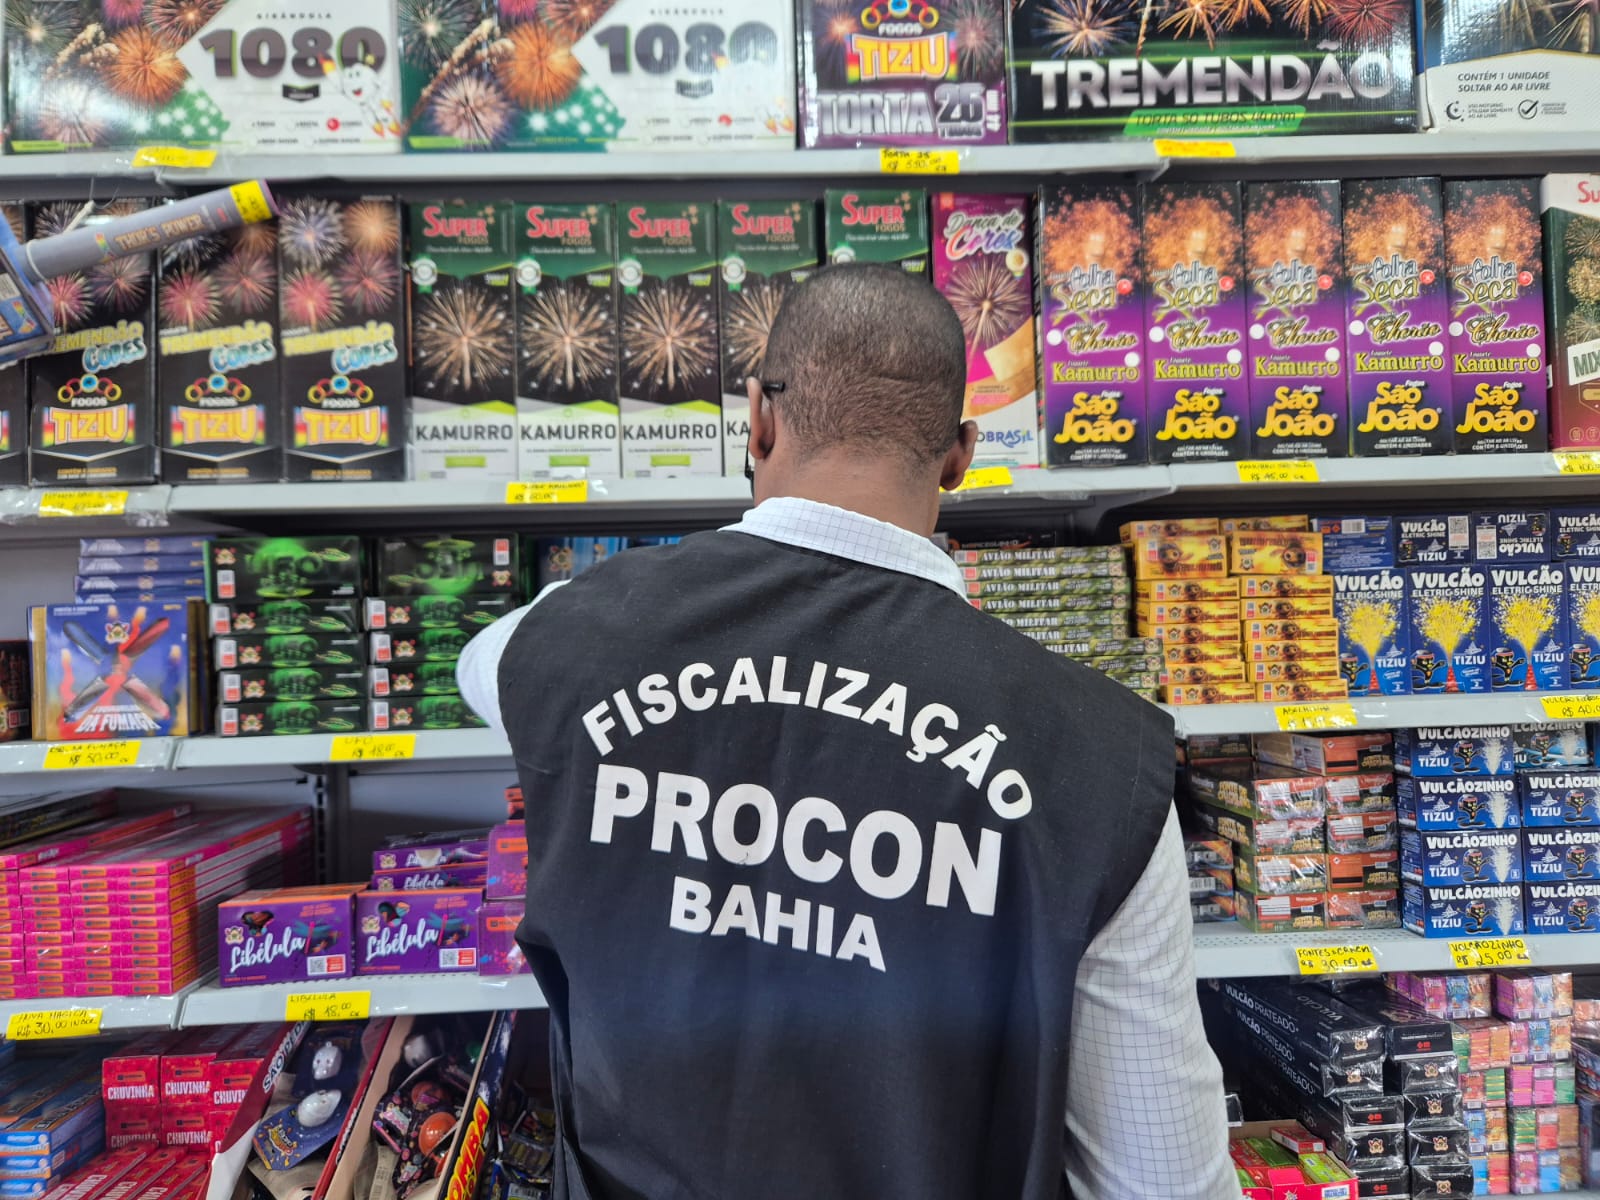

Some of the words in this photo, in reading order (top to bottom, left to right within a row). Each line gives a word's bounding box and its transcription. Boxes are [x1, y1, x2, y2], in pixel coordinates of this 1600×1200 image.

[878, 24, 923, 36] FOGOS
[199, 27, 386, 78] 1080
[594, 21, 777, 75] 1080
[850, 34, 951, 81] TIZIU
[1030, 40, 1395, 110] TREMENDÃO
[1457, 70, 1497, 82] CONTÉM
[1507, 71, 1550, 80] UNIDADE
[1457, 84, 1492, 92] SOLTAR
[1494, 83, 1508, 92] AO
[1510, 83, 1523, 91] AR
[1525, 82, 1551, 91] LIVRE
[817, 91, 935, 135] TORTA
[1136, 114, 1177, 126] TORTA
[1205, 111, 1247, 124] TUBOS
[944, 225, 1022, 259] Cores
[1053, 359, 1140, 383] Kamurro
[1154, 356, 1242, 380] Kamurro
[1255, 354, 1339, 377] Kamurro
[1355, 352, 1444, 374] Kamurro
[1454, 353, 1541, 374] Kamurro
[1175, 389, 1220, 413] São
[1274, 386, 1318, 411] São
[1376, 381, 1422, 405] São
[1473, 382, 1519, 406] São
[1072, 392, 1118, 416] São
[50, 406, 128, 445] TIZIU
[178, 407, 259, 444] TIZIU
[302, 407, 382, 445] TIZIU
[1156, 408, 1237, 440] João
[1256, 405, 1335, 437] João
[1357, 401, 1440, 432] João
[1455, 402, 1536, 434] João
[416, 424, 513, 441] KAMURRO
[520, 423, 616, 440] KAMURRO
[623, 423, 717, 440] KAMURRO
[1054, 412, 1135, 444] João
[1401, 518, 1446, 532] VULCÃO
[1498, 513, 1527, 523] TIZIU
[982, 550, 1011, 561] AVIÃO
[1015, 549, 1055, 560] MILITAR
[1417, 552, 1447, 562] TIZIU
[982, 566, 1011, 578] AVIÃO
[1014, 566, 1056, 577] MILITAR
[1334, 570, 1403, 591] VULCÃO
[1411, 565, 1485, 588] VULCÃO
[1490, 564, 1564, 586] VULCÃO
[985, 582, 1014, 593] AVIÃO
[1018, 582, 1060, 593] MILITAR
[1374, 590, 1403, 599] SHINE
[1454, 587, 1484, 596] SHINE
[1533, 584, 1563, 594] SHINE
[985, 598, 1015, 610] AVIÃO
[1019, 598, 1060, 609] MILITAR
[1376, 656, 1407, 668] TIZIU
[1454, 655, 1486, 666] TIZIU
[1533, 652, 1564, 663] TIZIU
[582, 655, 1032, 819] FISCALIZAÇÃO
[1418, 757, 1449, 768] TIZIU
[1420, 777, 1514, 794] VULCÃOZINHO
[1423, 812, 1454, 822] TIZIU
[1531, 807, 1561, 817] TIZIU
[590, 763, 1002, 916] PROCON
[1427, 832, 1517, 849] VULCÃOZINHO
[1429, 867, 1459, 878] TIZIU
[1531, 863, 1562, 874] TIZIU
[1429, 884, 1521, 900] VULCÃOZINHO
[669, 875, 886, 972] BAHIA
[1431, 918, 1462, 929] TIZIU
[1533, 916, 1564, 927] TIZIU
[229, 926, 306, 974] Libélula
[366, 918, 439, 962] Libélula
[1225, 983, 1254, 1009] VULCÃO
[1254, 1003, 1296, 1034] PRATEADO
[107, 1084, 155, 1100] CHUVINHA
